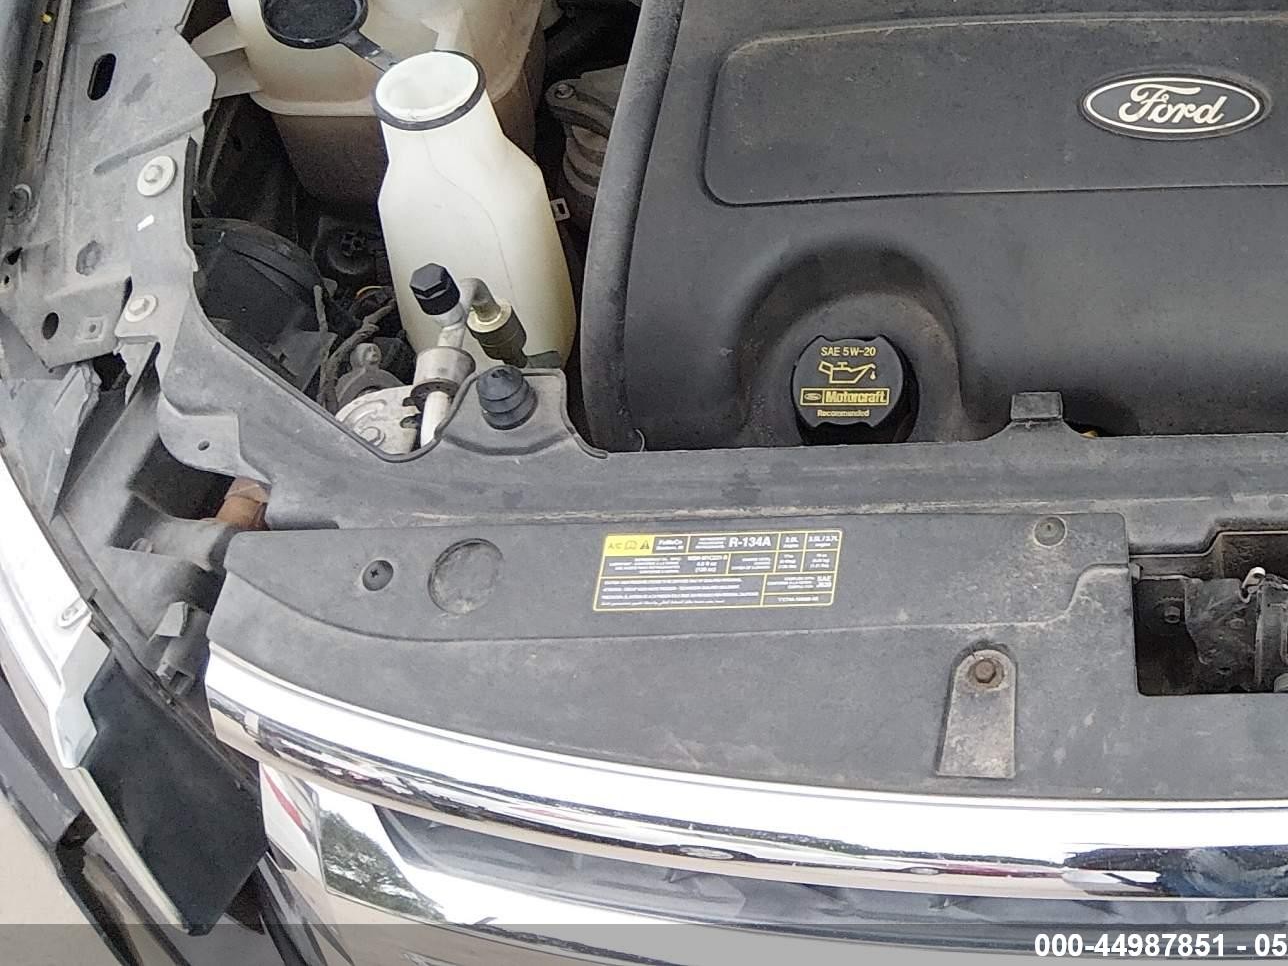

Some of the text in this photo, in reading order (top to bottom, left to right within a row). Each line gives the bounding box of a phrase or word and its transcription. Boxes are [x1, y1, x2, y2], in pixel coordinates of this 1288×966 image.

[1118, 84, 1228, 124] Ford
[820, 346, 877, 357] SAE 5W-20
[825, 391, 887, 404] Motorcraft
[817, 409, 870, 418] Recommended
[728, 536, 772, 548] R-134A
